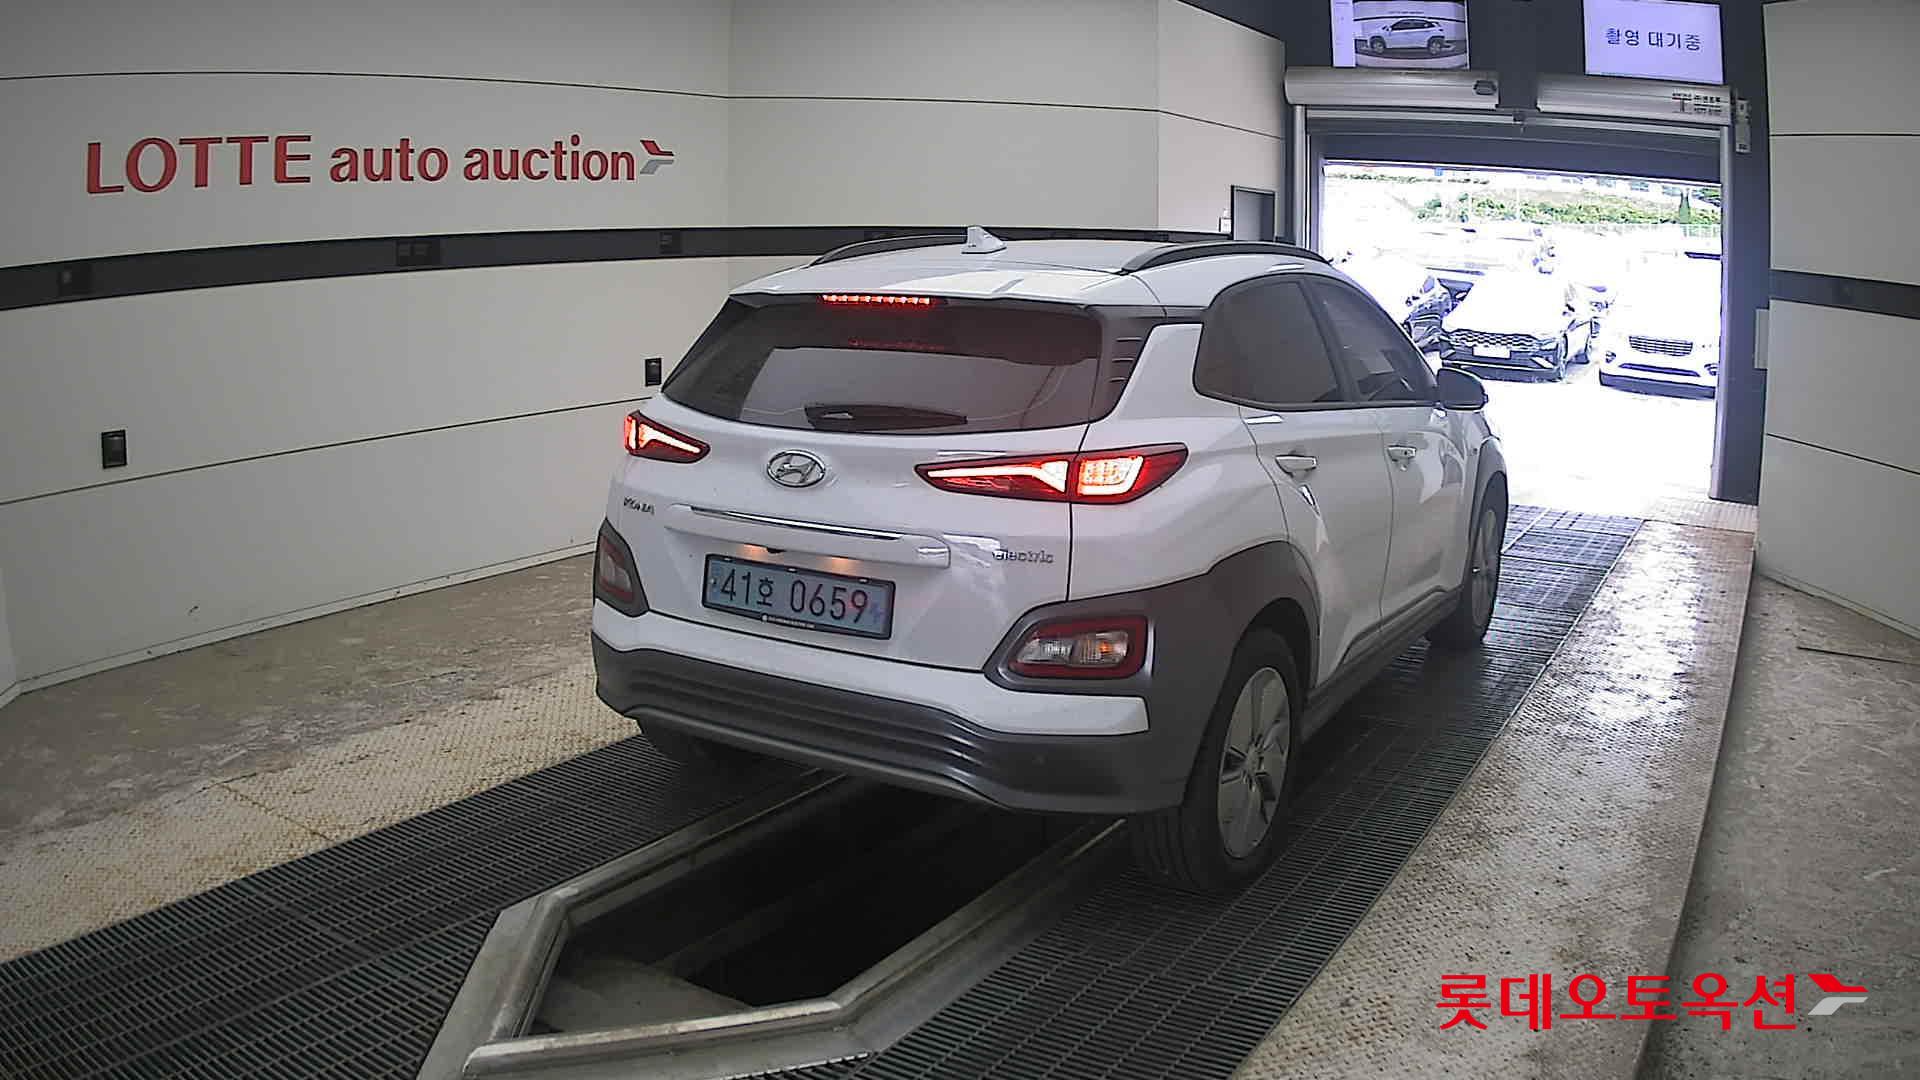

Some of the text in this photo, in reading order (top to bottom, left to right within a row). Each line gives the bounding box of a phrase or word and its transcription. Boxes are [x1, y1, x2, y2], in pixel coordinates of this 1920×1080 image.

[1606, 27, 1701, 51] 촬영 대기중
[86, 134, 636, 194] LOTTE auto auction
[720, 568, 868, 624] 41호 0659
